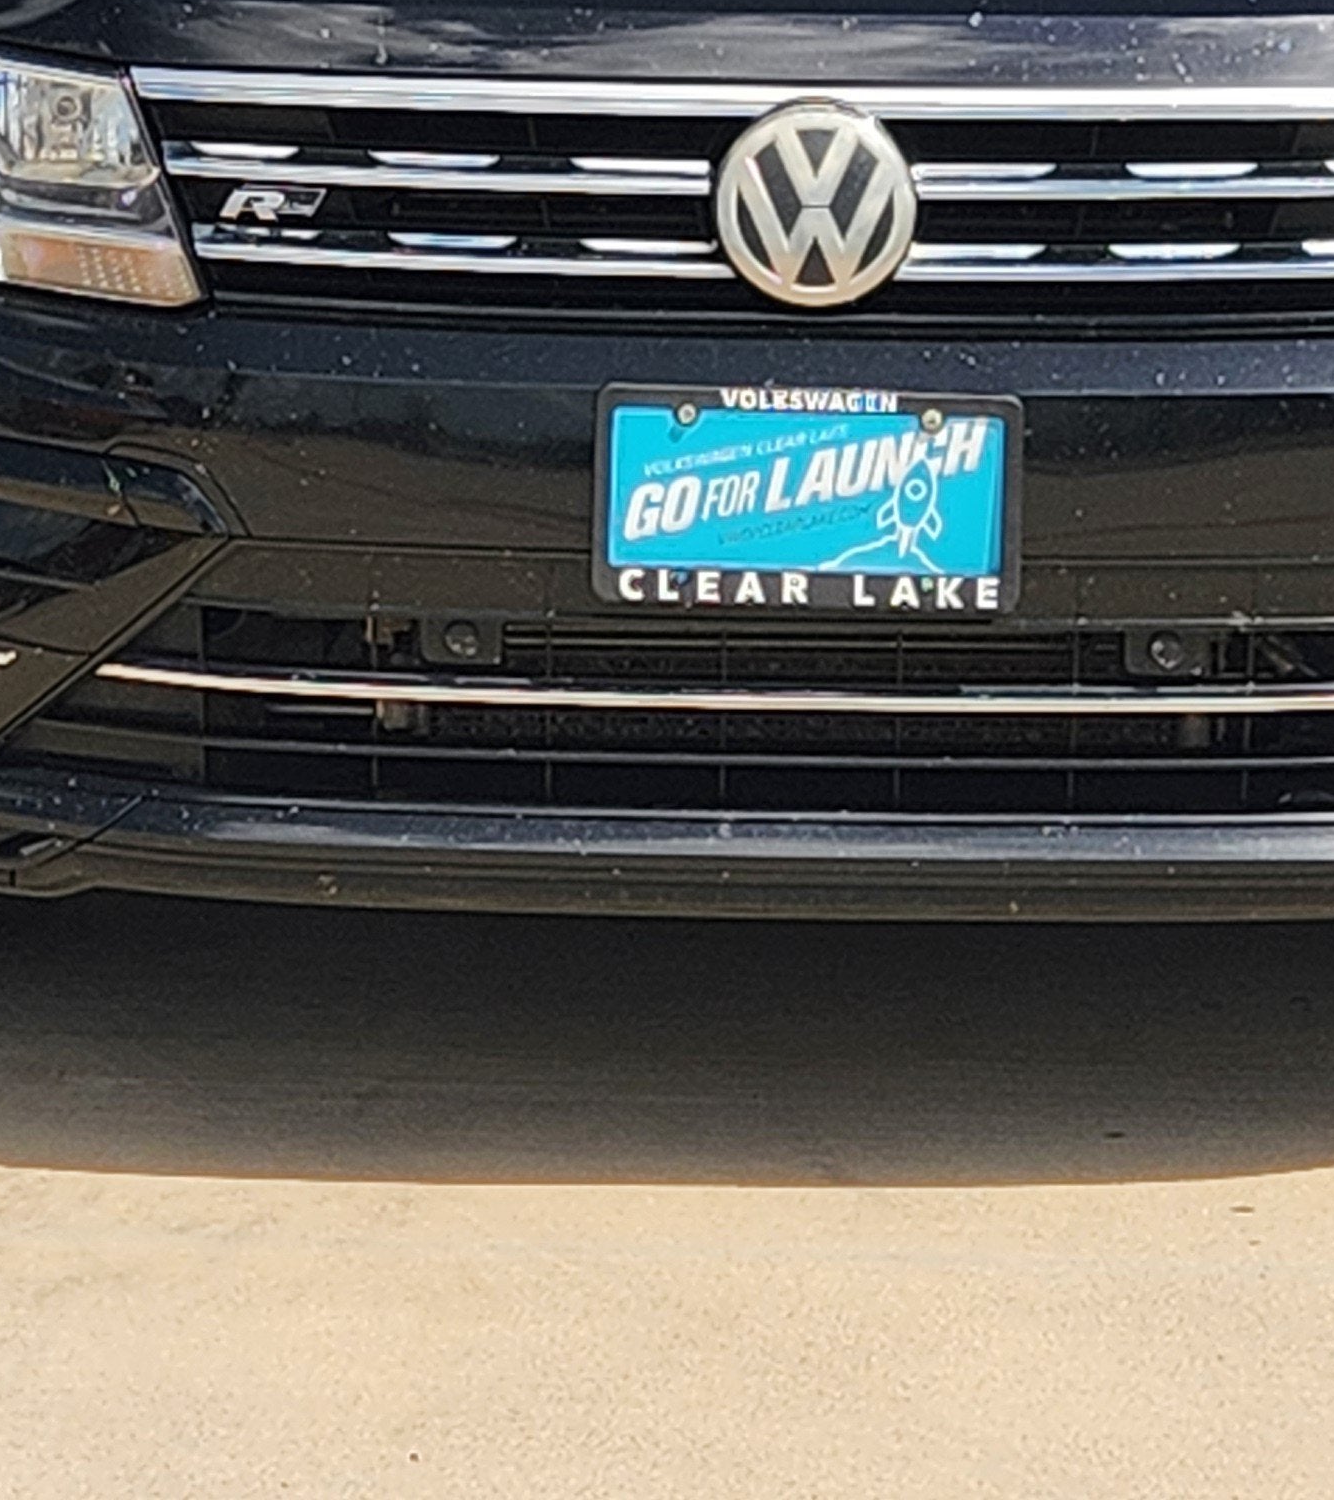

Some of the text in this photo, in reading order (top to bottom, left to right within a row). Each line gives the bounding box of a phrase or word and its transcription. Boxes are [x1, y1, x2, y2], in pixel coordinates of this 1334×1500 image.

[718, 108, 915, 304] VW
[720, 387, 898, 413] VOLKSWAGEN
[756, 430, 808, 457] CLEAR
[624, 474, 703, 541] GO
[701, 469, 761, 522] FOR
[764, 415, 988, 513] LAUNCH
[618, 568, 1001, 611] CLEAR LAKE
